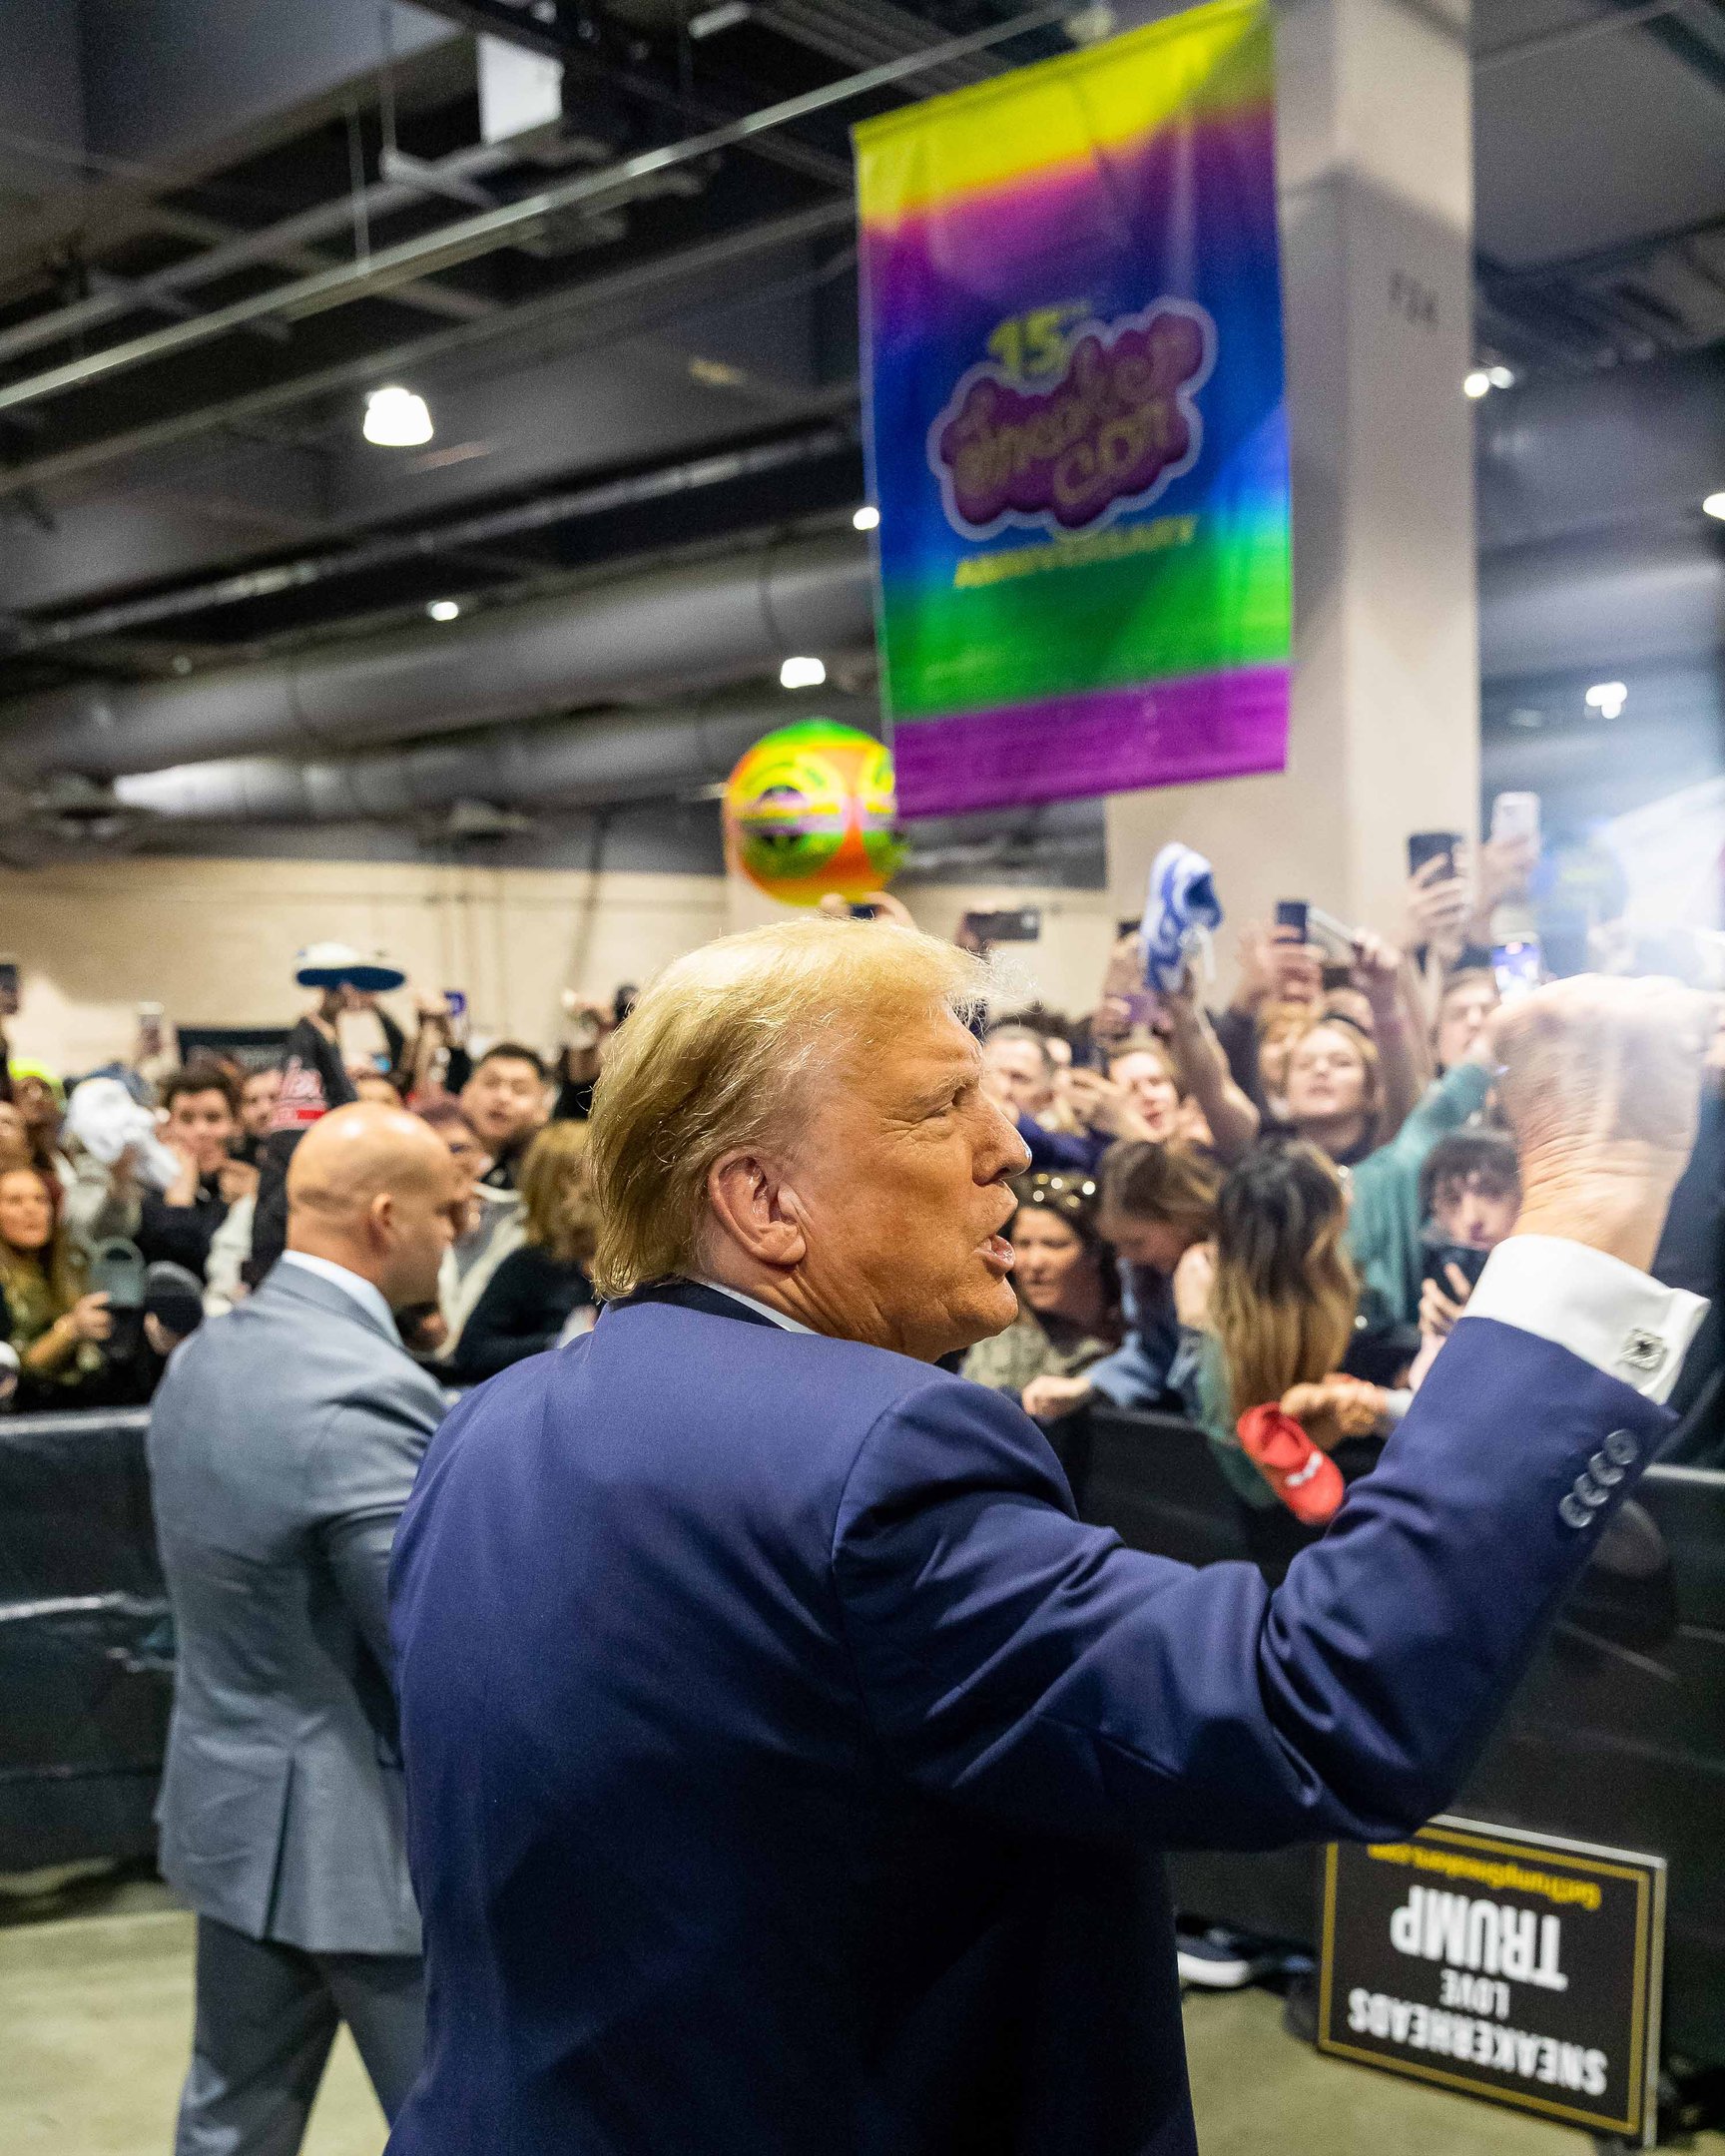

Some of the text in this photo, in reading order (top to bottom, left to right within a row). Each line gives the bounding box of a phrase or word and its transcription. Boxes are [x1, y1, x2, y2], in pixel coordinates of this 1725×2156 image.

[1390, 1884, 1568, 1991] TRUMP
[1347, 1987, 1608, 2096] SNEAKERHEADS
[1438, 1969, 1510, 2019] LOVE
